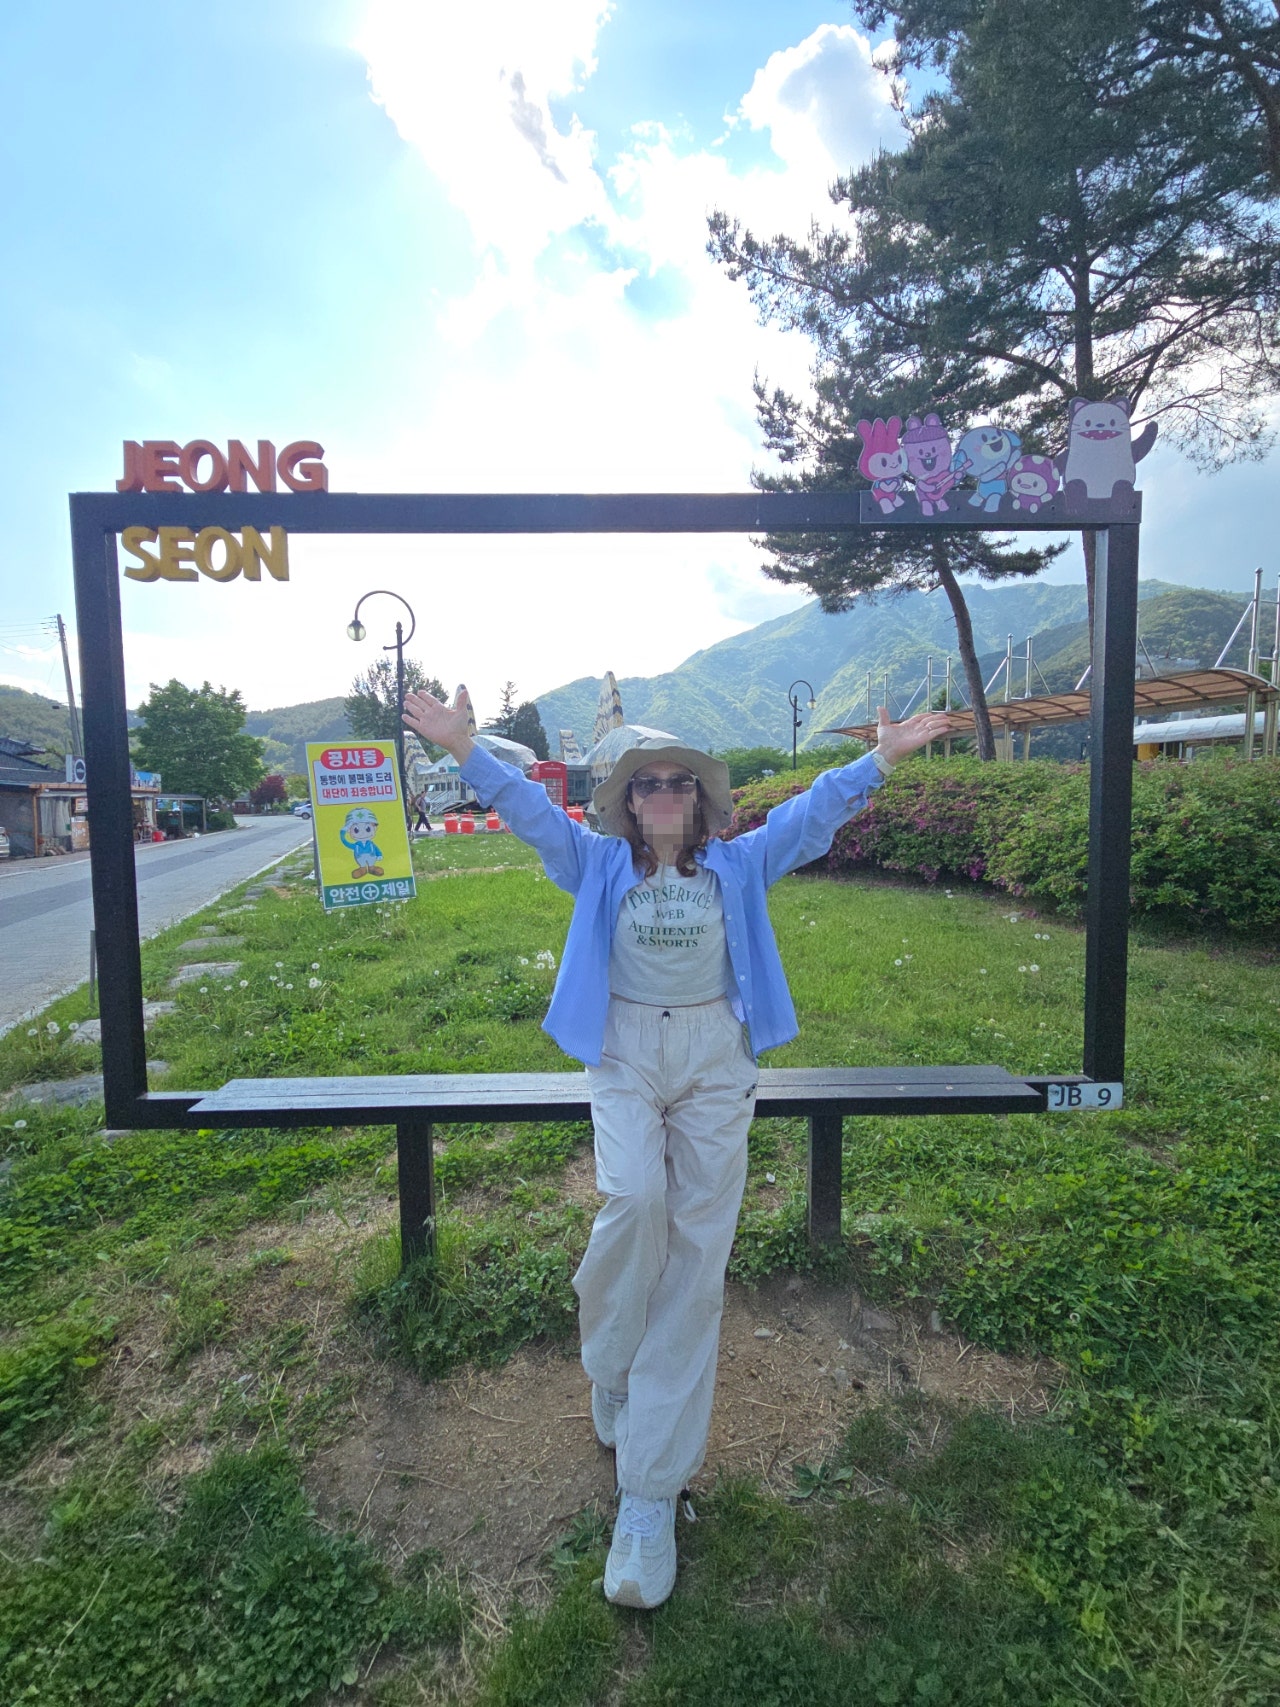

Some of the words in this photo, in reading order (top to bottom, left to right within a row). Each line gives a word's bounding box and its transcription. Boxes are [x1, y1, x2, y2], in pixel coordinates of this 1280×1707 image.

[115, 439, 329, 493] JEONG
[121, 525, 290, 583] SEON
[327, 749, 377, 768] 공사중
[320, 774, 346, 786] 통행에
[348, 773, 374, 785] 불편을
[375, 772, 392, 783] 드려
[322, 787, 349, 799] 대단히
[351, 785, 393, 798] 죄송합니다
[329, 886, 360, 904] 안전
[381, 880, 410, 897] 제일
[628, 920, 708, 936] AUTHENTIC
[1054, 1086, 1082, 1106] JB
[1097, 1088, 1112, 1106] 9
